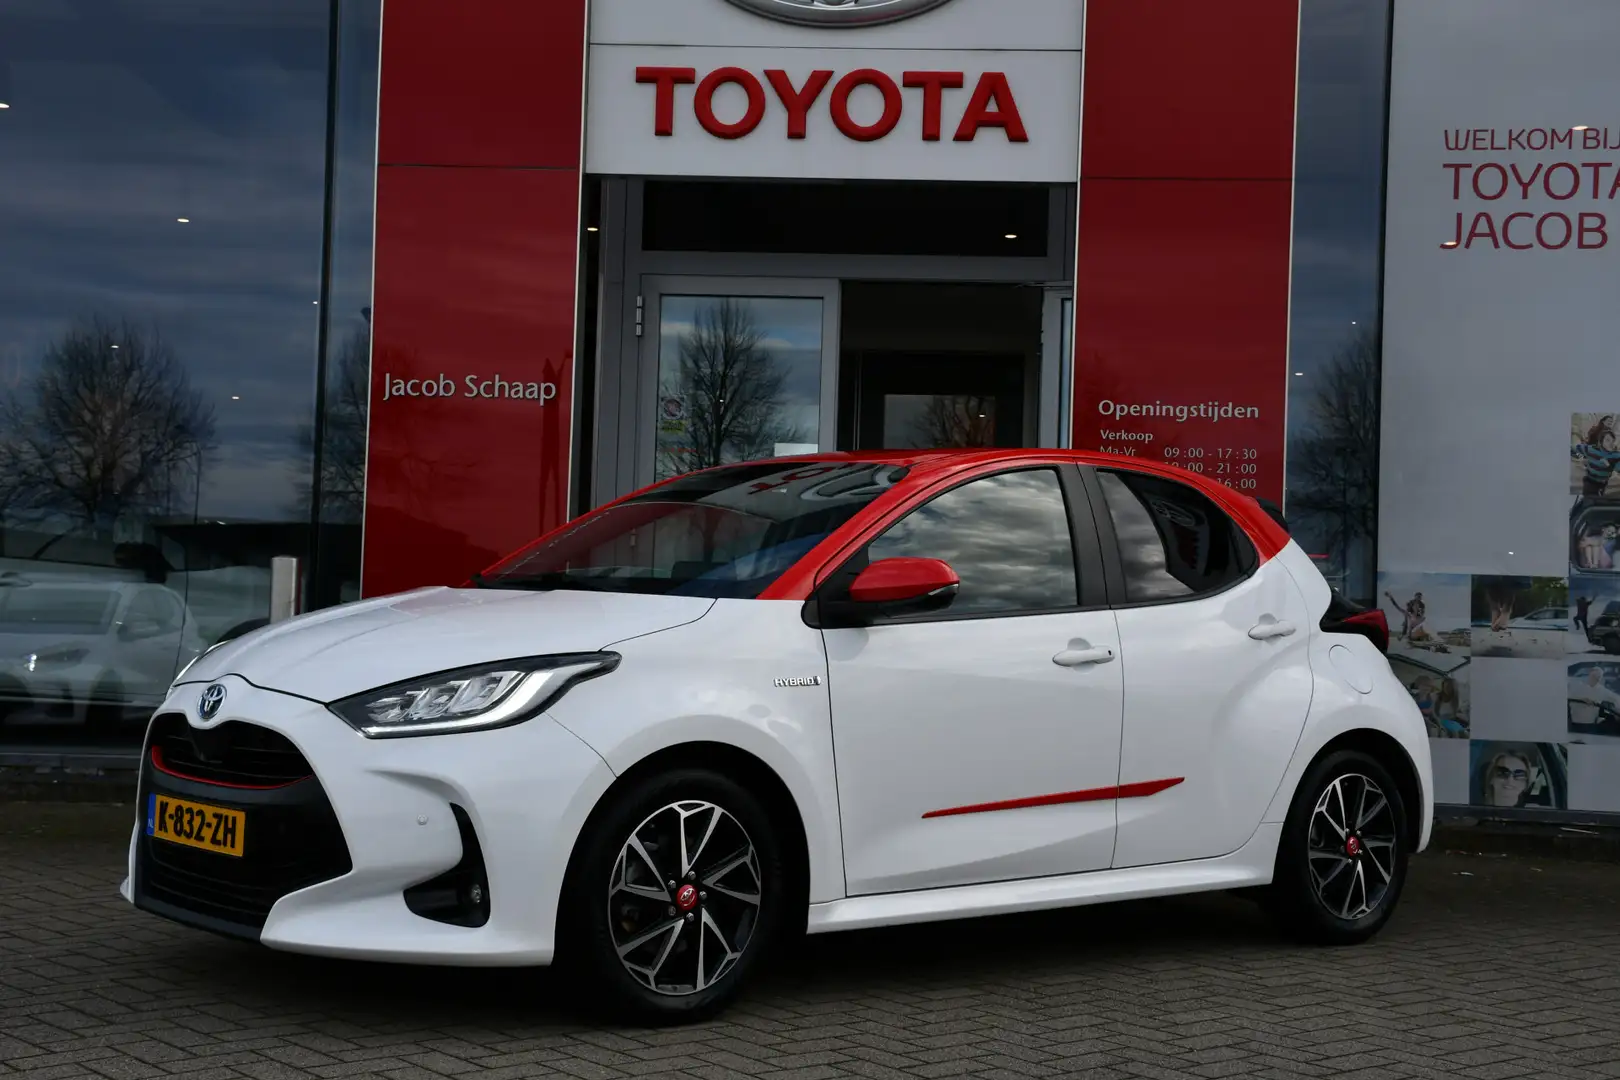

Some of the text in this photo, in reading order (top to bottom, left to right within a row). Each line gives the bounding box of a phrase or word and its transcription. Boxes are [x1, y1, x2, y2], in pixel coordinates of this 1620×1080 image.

[635, 66, 1029, 142] TOYOTA
[1444, 128, 1573, 150] WELKOM
[1439, 212, 1608, 250] JACOB
[383, 373, 556, 406] Jacob Schaap
[1098, 400, 1259, 422] Openingstijden
[1100, 429, 1153, 444] Verkoop
[1100, 445, 1136, 456] Ma-Vr
[774, 677, 815, 687] HYBRID
[158, 801, 237, 849] K-832-ZH
